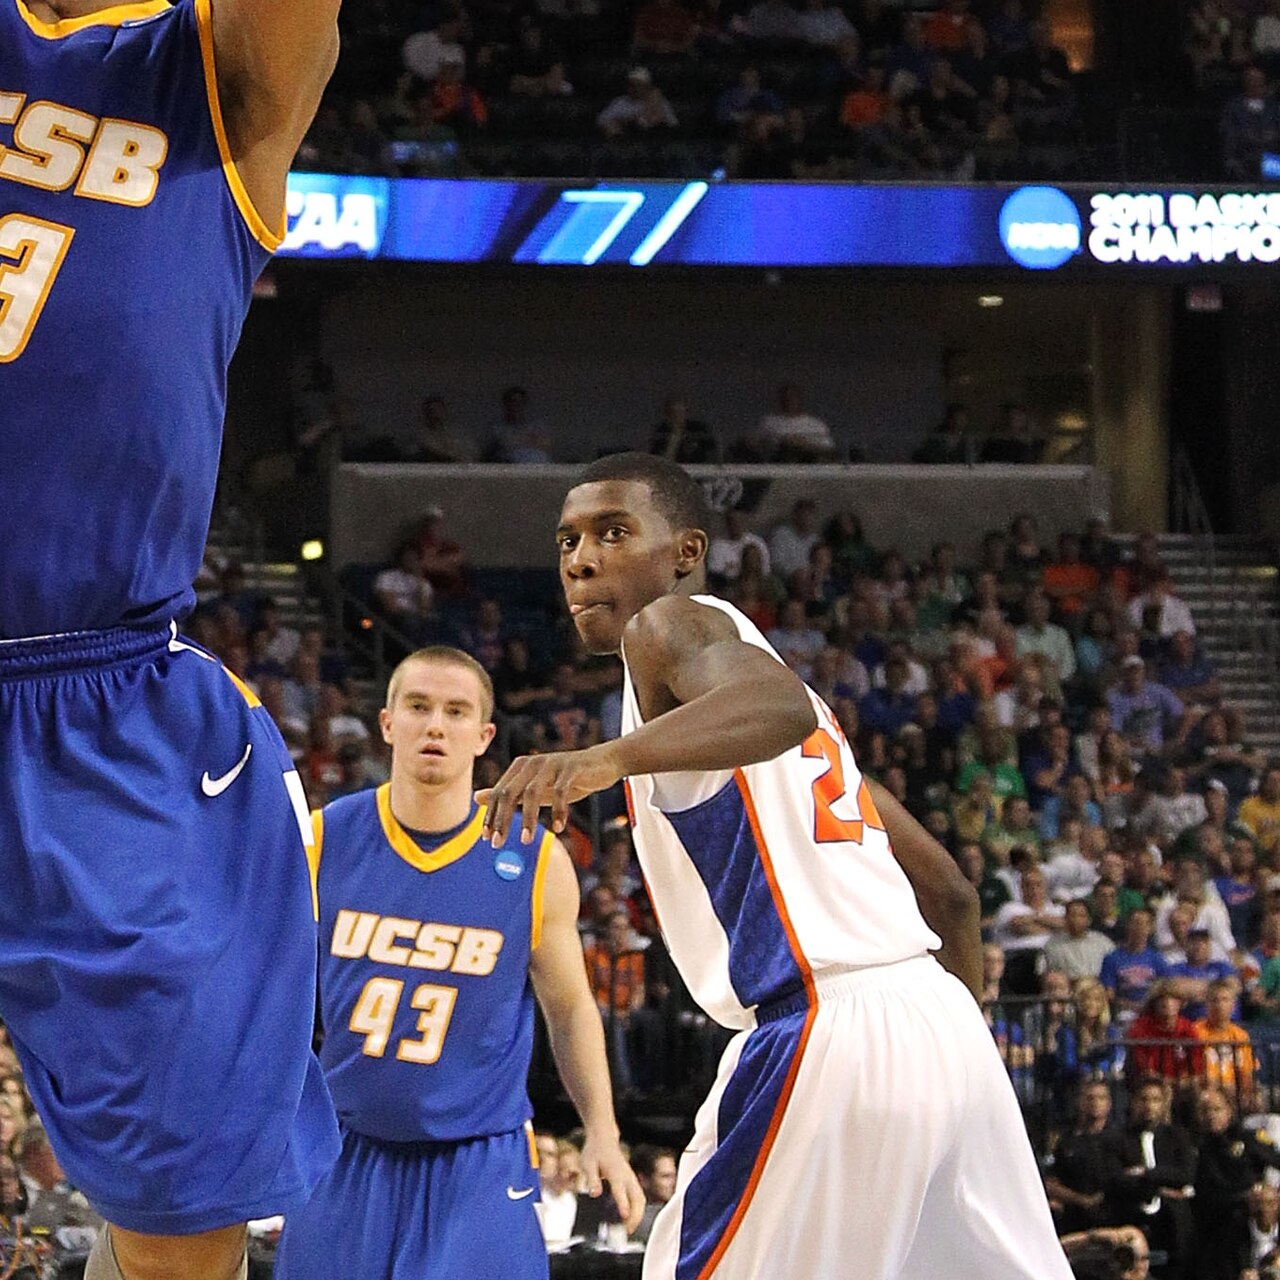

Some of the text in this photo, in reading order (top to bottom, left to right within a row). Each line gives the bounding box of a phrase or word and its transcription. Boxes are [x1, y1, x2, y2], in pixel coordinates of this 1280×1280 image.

[277, 191, 377, 250] CAA
[1089, 193, 1164, 226] 2011
[330, 908, 504, 977] UCSB
[349, 976, 458, 1065] 43
